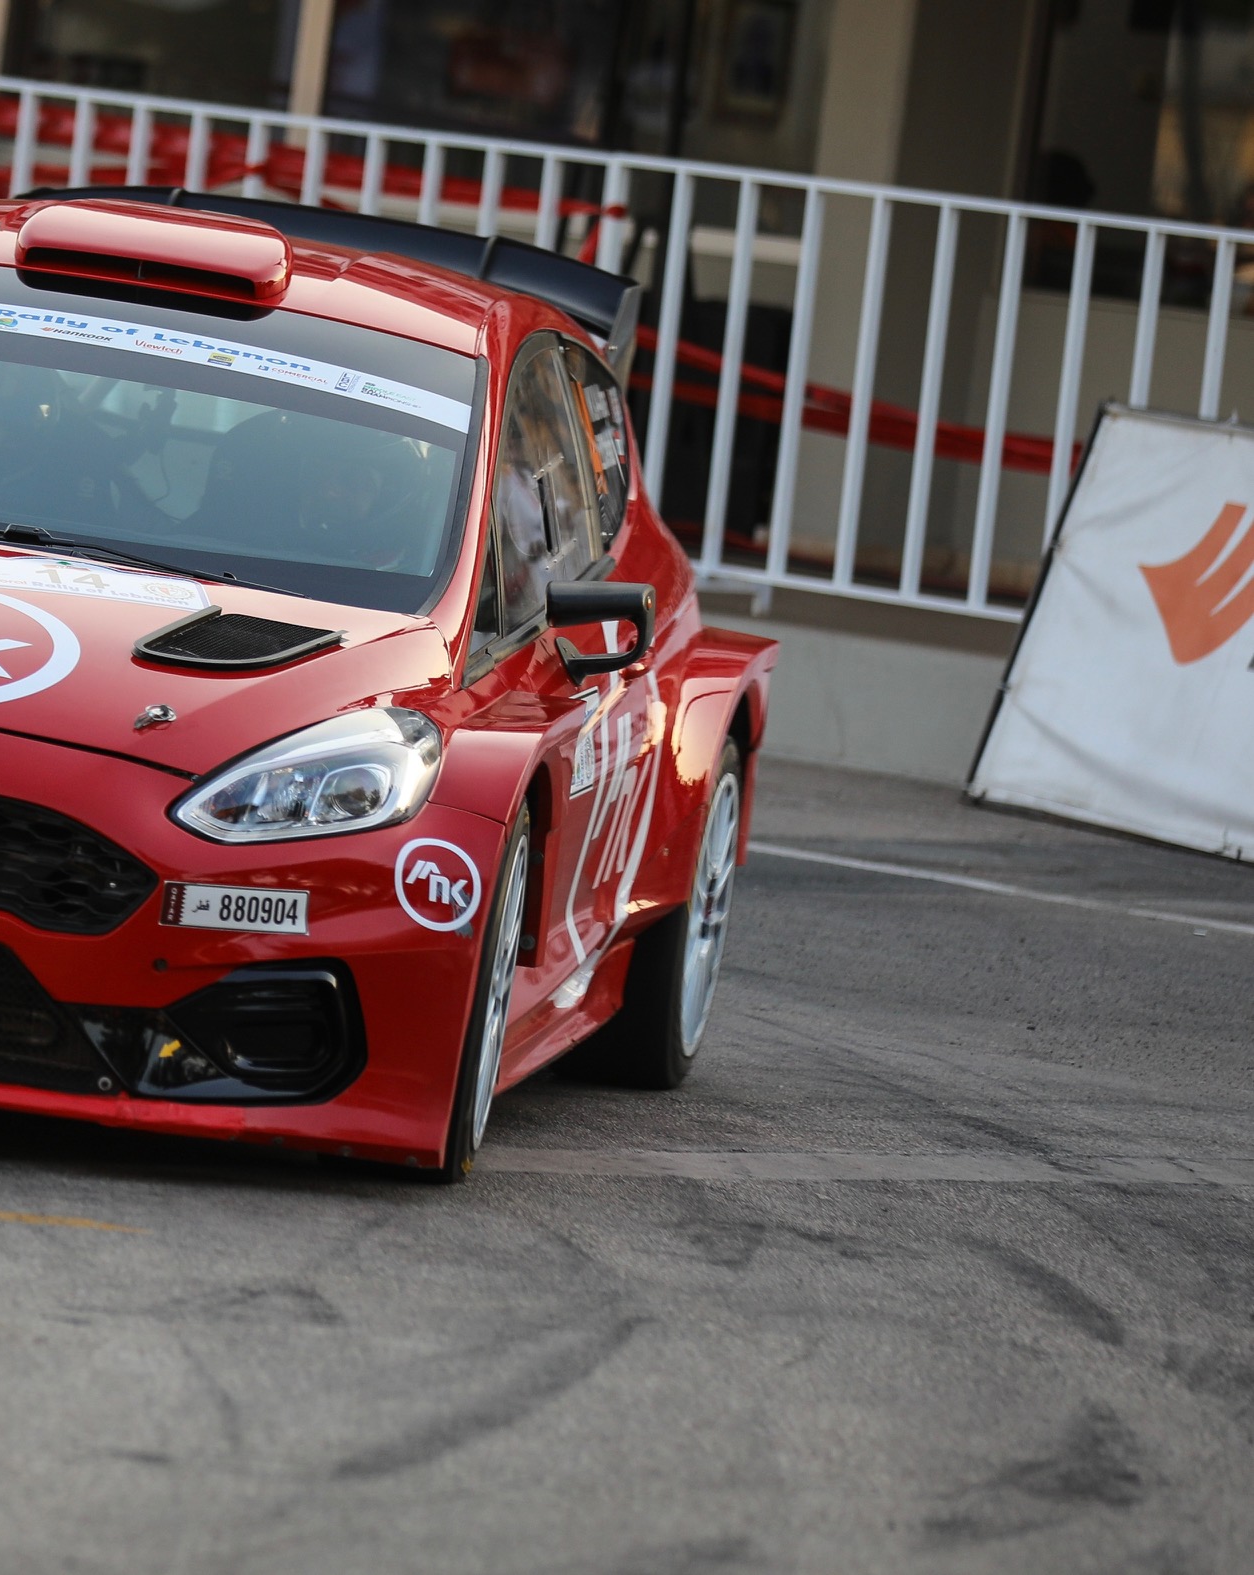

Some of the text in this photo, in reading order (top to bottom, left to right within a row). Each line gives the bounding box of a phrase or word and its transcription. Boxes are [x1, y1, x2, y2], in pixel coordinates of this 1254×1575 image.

[102, 326, 139, 336] of
[153, 333, 312, 371] Lebanon
[31, 580, 80, 592] Rally
[86, 587, 103, 595] of
[110, 589, 190, 606] Lebanon
[34, 568, 111, 590] 14
[219, 894, 299, 926] 880904
